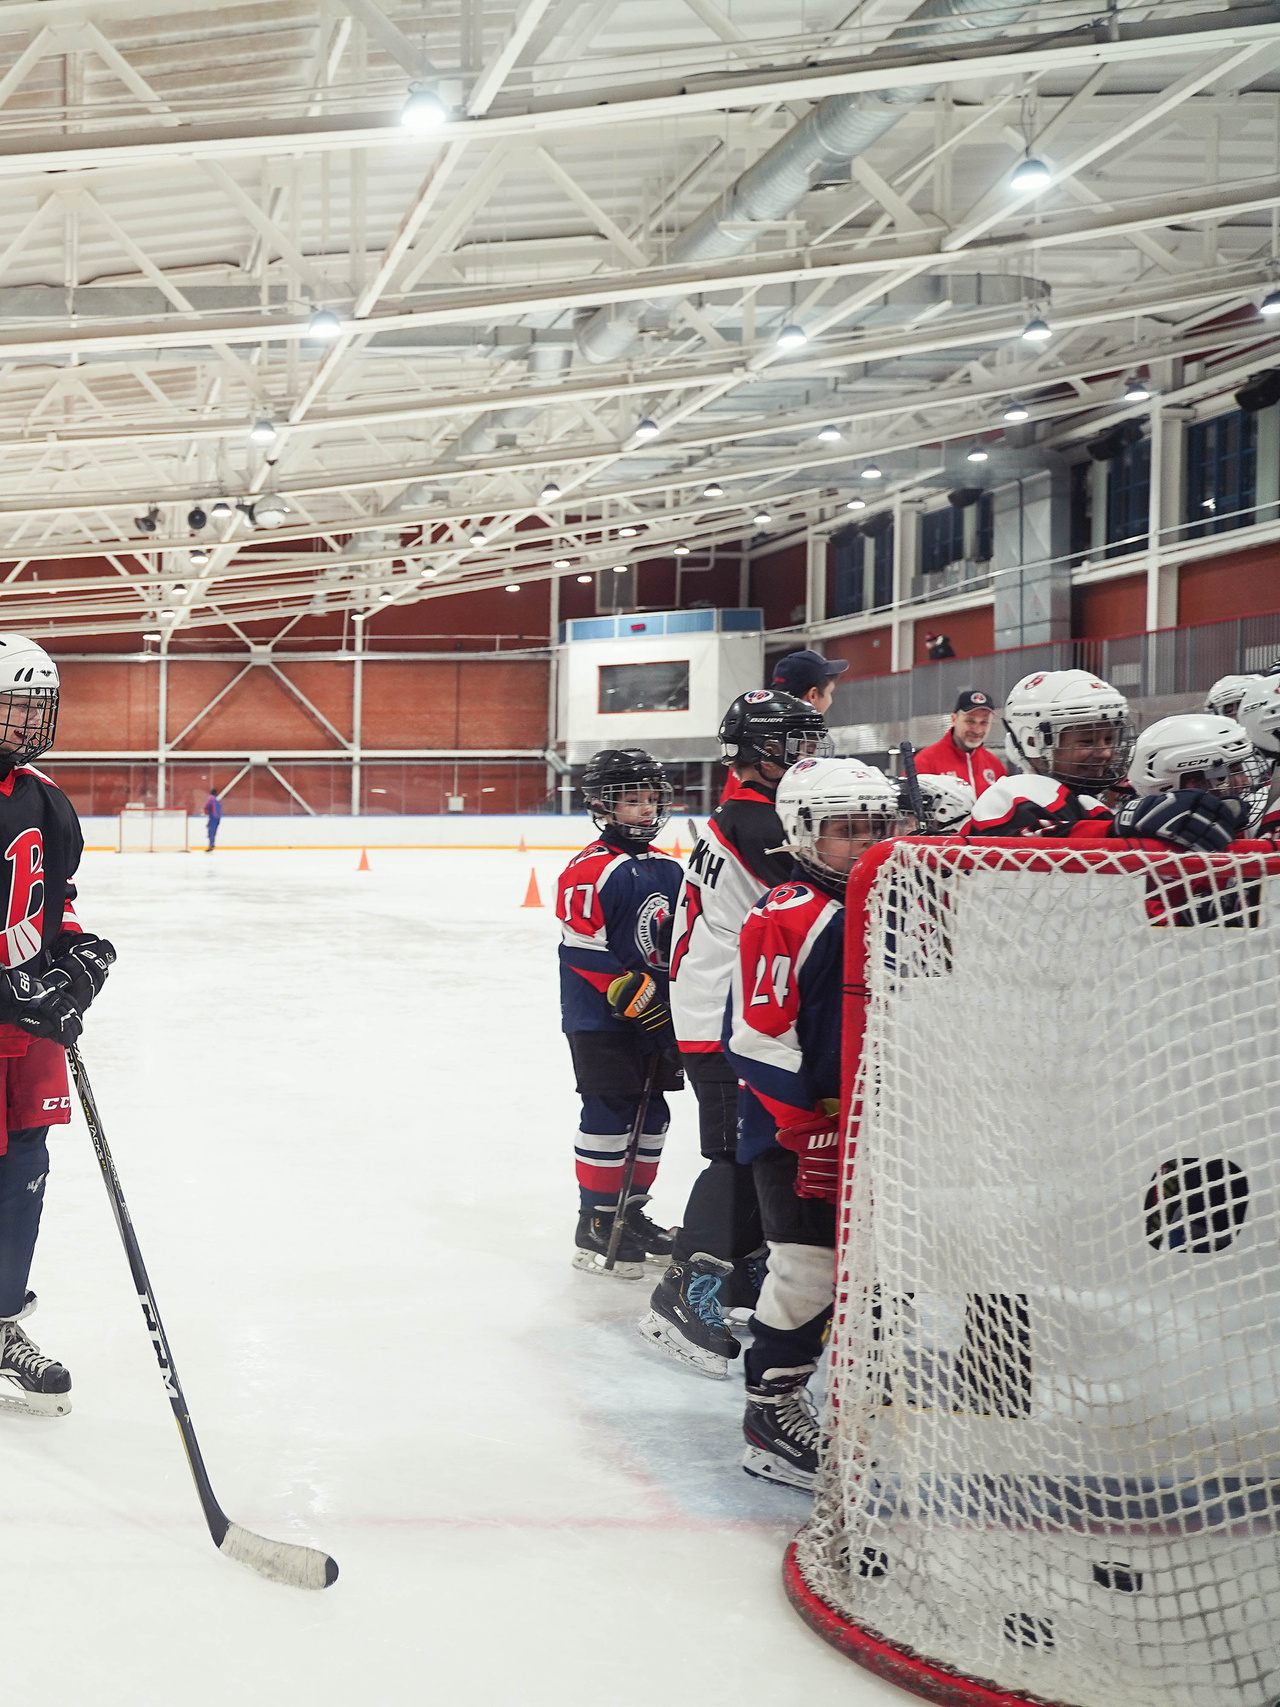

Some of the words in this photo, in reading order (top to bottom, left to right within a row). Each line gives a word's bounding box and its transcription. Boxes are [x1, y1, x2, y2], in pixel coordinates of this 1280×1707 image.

[1244, 700, 1268, 713] CCM
[1176, 758, 1210, 768] CCM
[564, 884, 595, 922] 17
[750, 954, 792, 1009] 24
[42, 1095, 71, 1112] CC
[88, 1123, 104, 1161] TACKS
